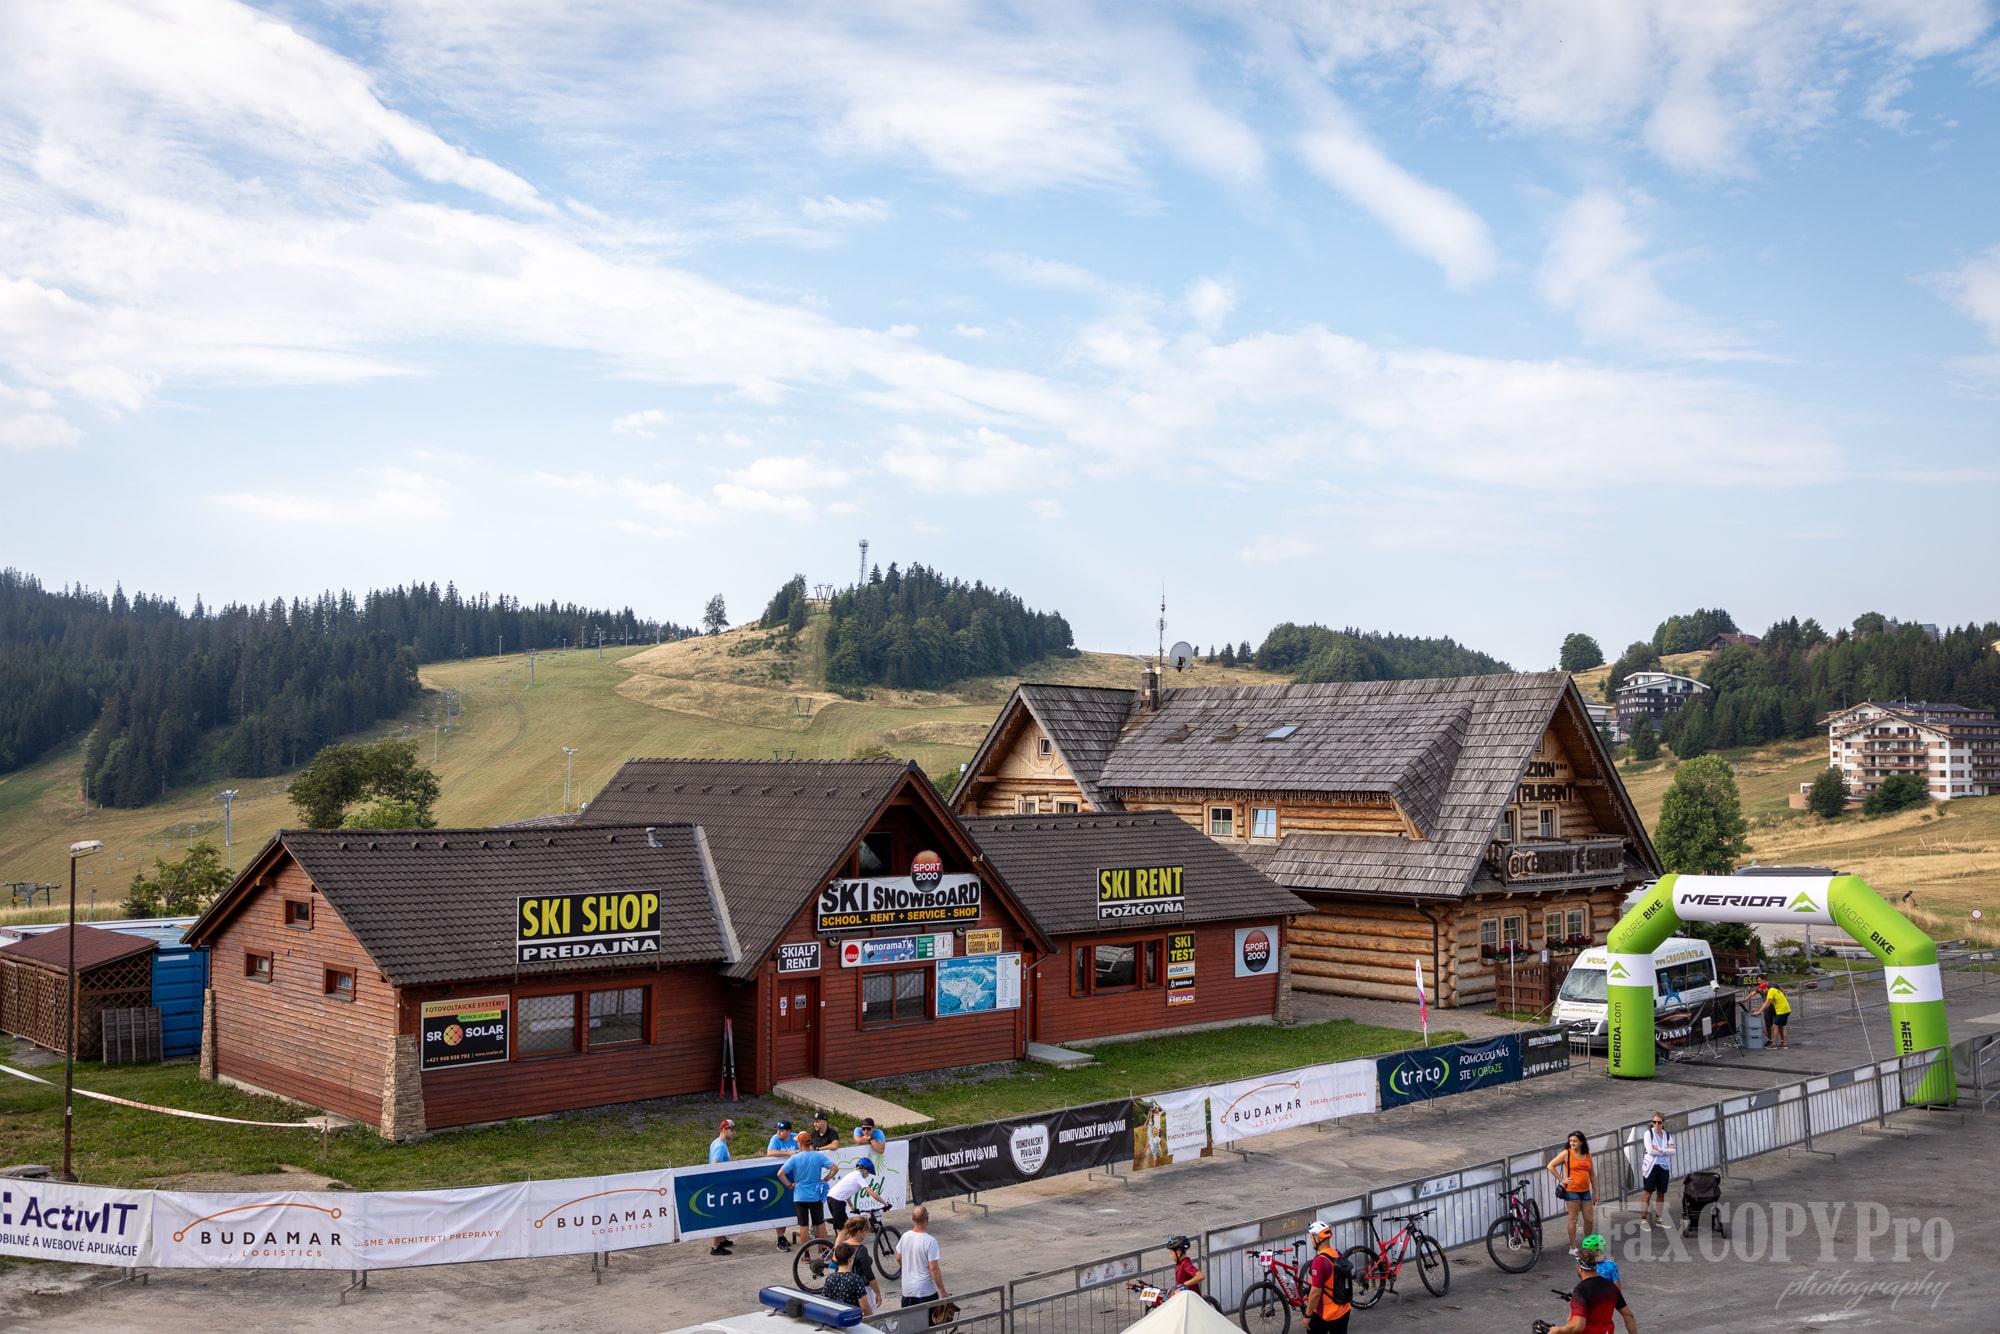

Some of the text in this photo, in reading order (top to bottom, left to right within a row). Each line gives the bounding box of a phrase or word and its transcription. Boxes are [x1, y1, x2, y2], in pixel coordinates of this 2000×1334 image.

[913, 862, 941, 872] SPORT
[915, 872, 938, 881] 2000
[1101, 867, 1184, 900] SKI RENT
[822, 881, 980, 913] SKI SNOWBOARD
[1680, 893, 1788, 908] MERIDA
[522, 893, 659, 937] SKI SHOP
[821, 914, 862, 927] SCHOOL
[870, 912, 896, 924] RENT
[907, 909, 946, 921] SERVICE
[953, 907, 978, 918] SHOP
[1101, 901, 1184, 918] POŽIČOVŇA
[1618, 898, 1664, 945] MORE BIKE
[1838, 902, 1896, 956] MORE BIKE
[522, 937, 658, 961] PREDAJŇA
[1174, 935, 1192, 949] SKI
[1244, 941, 1268, 952] SPORT
[781, 945, 818, 959] SKIALP
[1170, 948, 1195, 962] TEST
[1247, 951, 1267, 961] 2000
[786, 957, 813, 970] RENT
[425, 999, 505, 1014] FOTOVOLTAICKÉ SYSTÉMY
[426, 1024, 504, 1042] SR SOLAR
[1613, 1001, 1622, 1068] MERIDA.com
[1459, 1044, 1510, 1066] POMOCOU NÁS
[1401, 1067, 1440, 1086] traco
[1459, 1069, 1471, 1081] STE
[1471, 1068, 1478, 1079] V
[1234, 1098, 1302, 1123] BUDAMAR
[1255, 1113, 1294, 1128] LOGISTICS
[1059, 1122, 1097, 1144] DONOVALSKÝ
[706, 1186, 769, 1209] traco
[20, 1196, 139, 1236] ActivIT
[557, 1206, 668, 1229] BUDAMAR
[592, 1221, 654, 1236] LOGISTICS
[201, 1231, 342, 1246] BUDAMAR
[387, 1234, 447, 1246] ARCHITEKTI
[449, 1229, 501, 1241] PREPRAVY
[32, 1236, 40, 1248] A
[42, 1237, 85, 1253] WEBOVÉ
[87, 1241, 138, 1257] APLIKÁCIE
[242, 1249, 323, 1258] LOGISTICS
